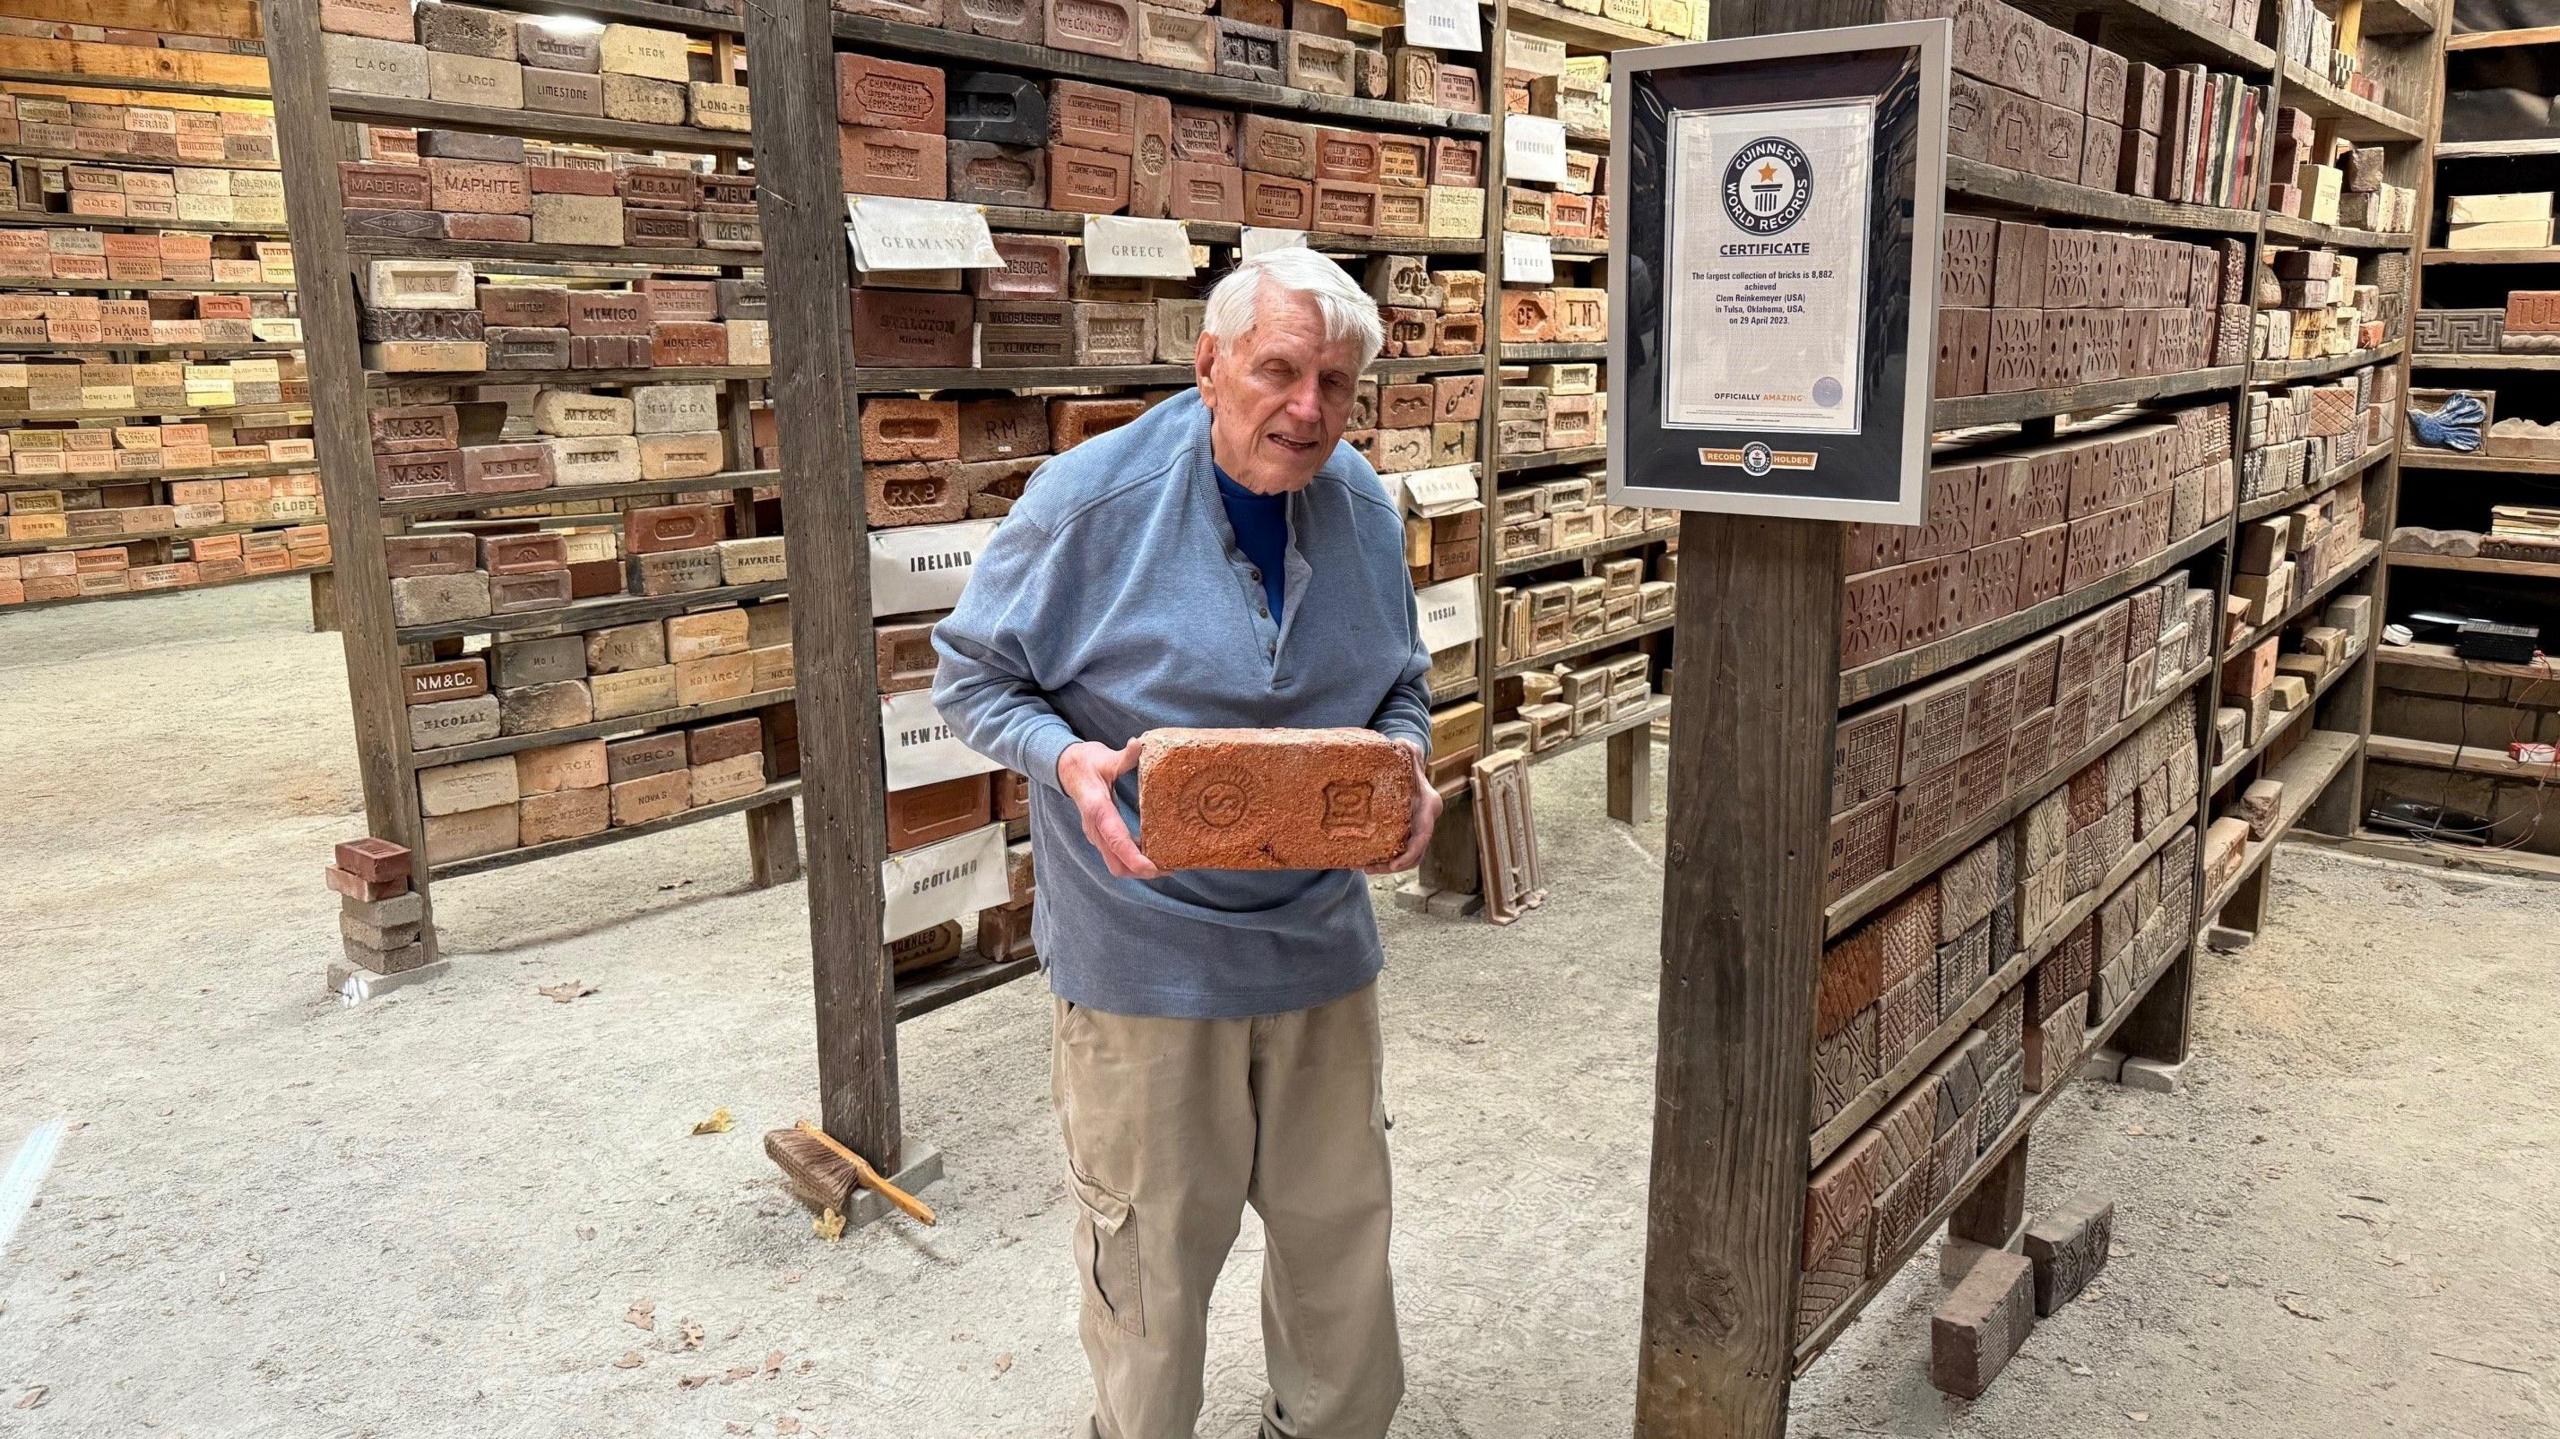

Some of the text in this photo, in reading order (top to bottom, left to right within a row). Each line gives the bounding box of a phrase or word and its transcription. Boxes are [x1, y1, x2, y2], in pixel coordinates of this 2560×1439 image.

[536, 85, 589, 105] LIMESTONE
[1735, 142, 1803, 171] GUINNESS
[350, 179, 418, 194] MADEIRA
[445, 176, 521, 197] MAPHITE
[1726, 177, 1810, 232] WORLD RECORDS
[717, 224, 754, 242] MBW
[880, 235, 969, 251] GERMANY
[1111, 244, 1164, 258] GREECE
[1719, 241, 1810, 255] CERTIFICATE
[1692, 272, 1704, 280] The
[1706, 272, 1730, 283] largest
[1732, 271, 1767, 280] collection
[1768, 271, 1777, 279] of
[1778, 271, 1801, 279] bricks
[1802, 270, 1809, 279] is
[1744, 283, 1777, 291] achieved
[1716, 293, 1806, 304] Clem Reinkemeyer (USA)
[583, 307, 639, 322] MIMICO
[1715, 305, 1722, 314] in
[1724, 305, 1745, 315] Tulsa,
[1747, 305, 1785, 315] Oklahoma,
[1740, 317, 1749, 325] 29
[1750, 316, 1768, 326] April
[1714, 392, 1803, 402] OFFICIALLY AMAZING
[985, 418, 1019, 441] RM
[1707, 452, 1810, 464] RECORD HOLDER
[891, 483, 937, 507] RKB
[271, 500, 316, 514] GLOBE
[910, 550, 973, 573] IRELAND
[1428, 605, 1457, 623] RUSSIA
[416, 672, 474, 692] NM&Co
[901, 724, 954, 747] NEW ZE
[912, 859, 978, 895] SCOTLAND
